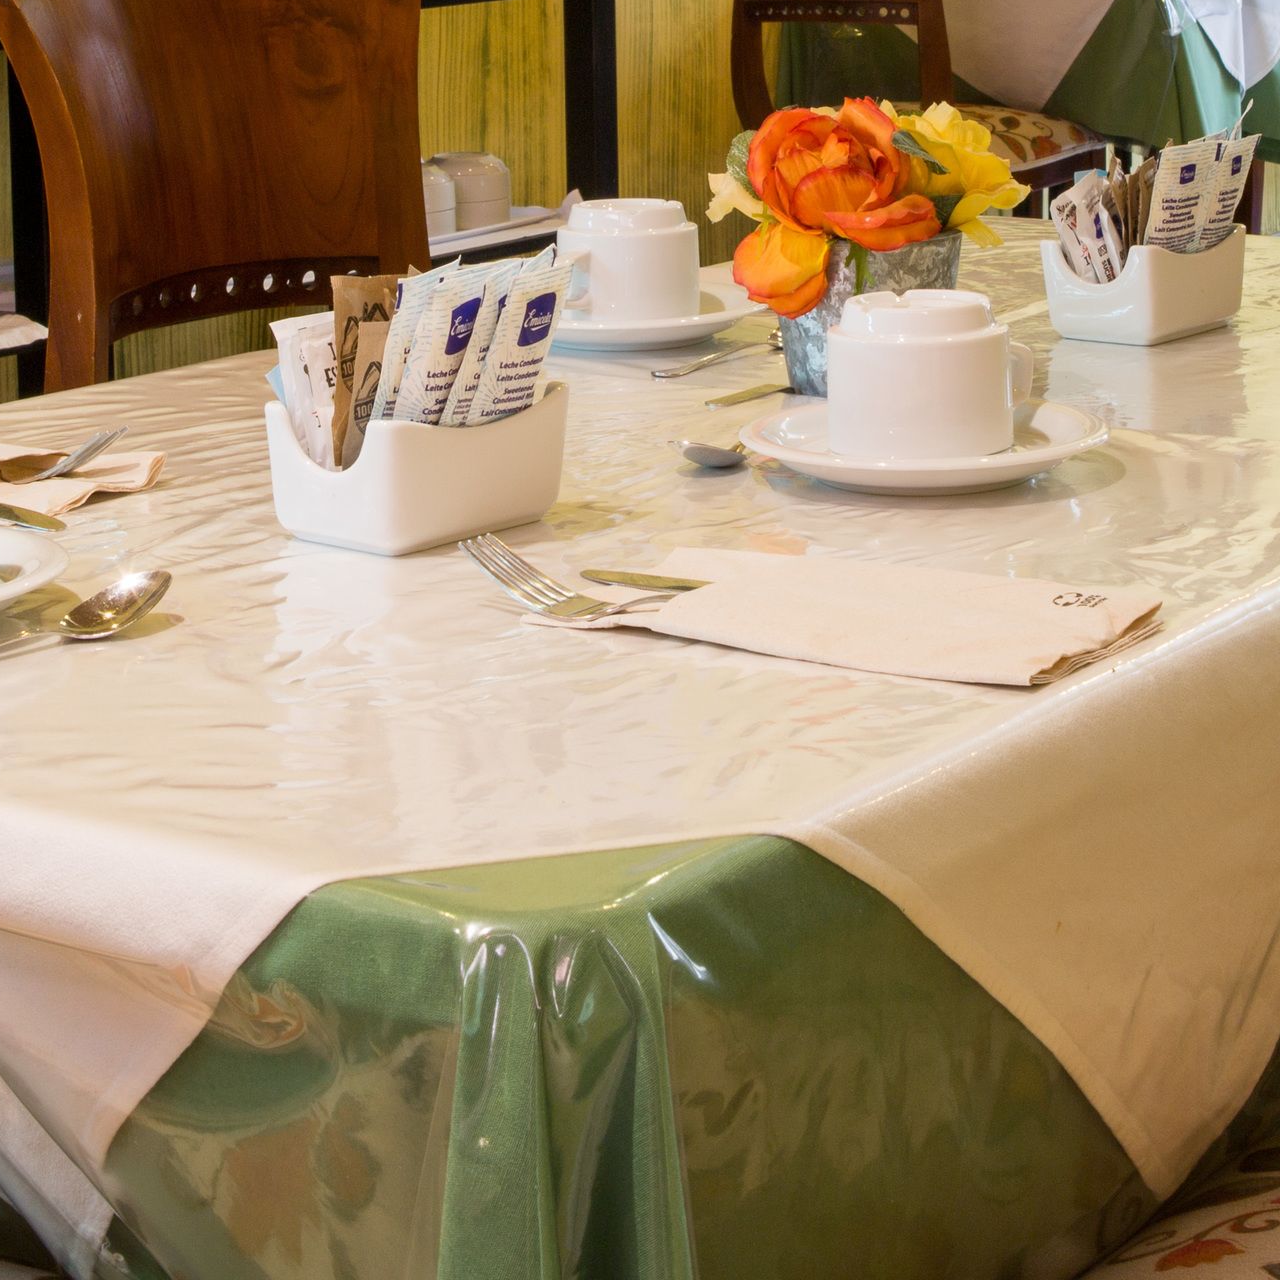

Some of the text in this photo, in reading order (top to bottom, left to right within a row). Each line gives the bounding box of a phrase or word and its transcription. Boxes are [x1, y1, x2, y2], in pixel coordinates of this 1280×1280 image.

[427, 370, 447, 378] Leche
[496, 374, 513, 382] Leite
[503, 383, 535, 395] Sweetened
[492, 394, 525, 404] Condensed
